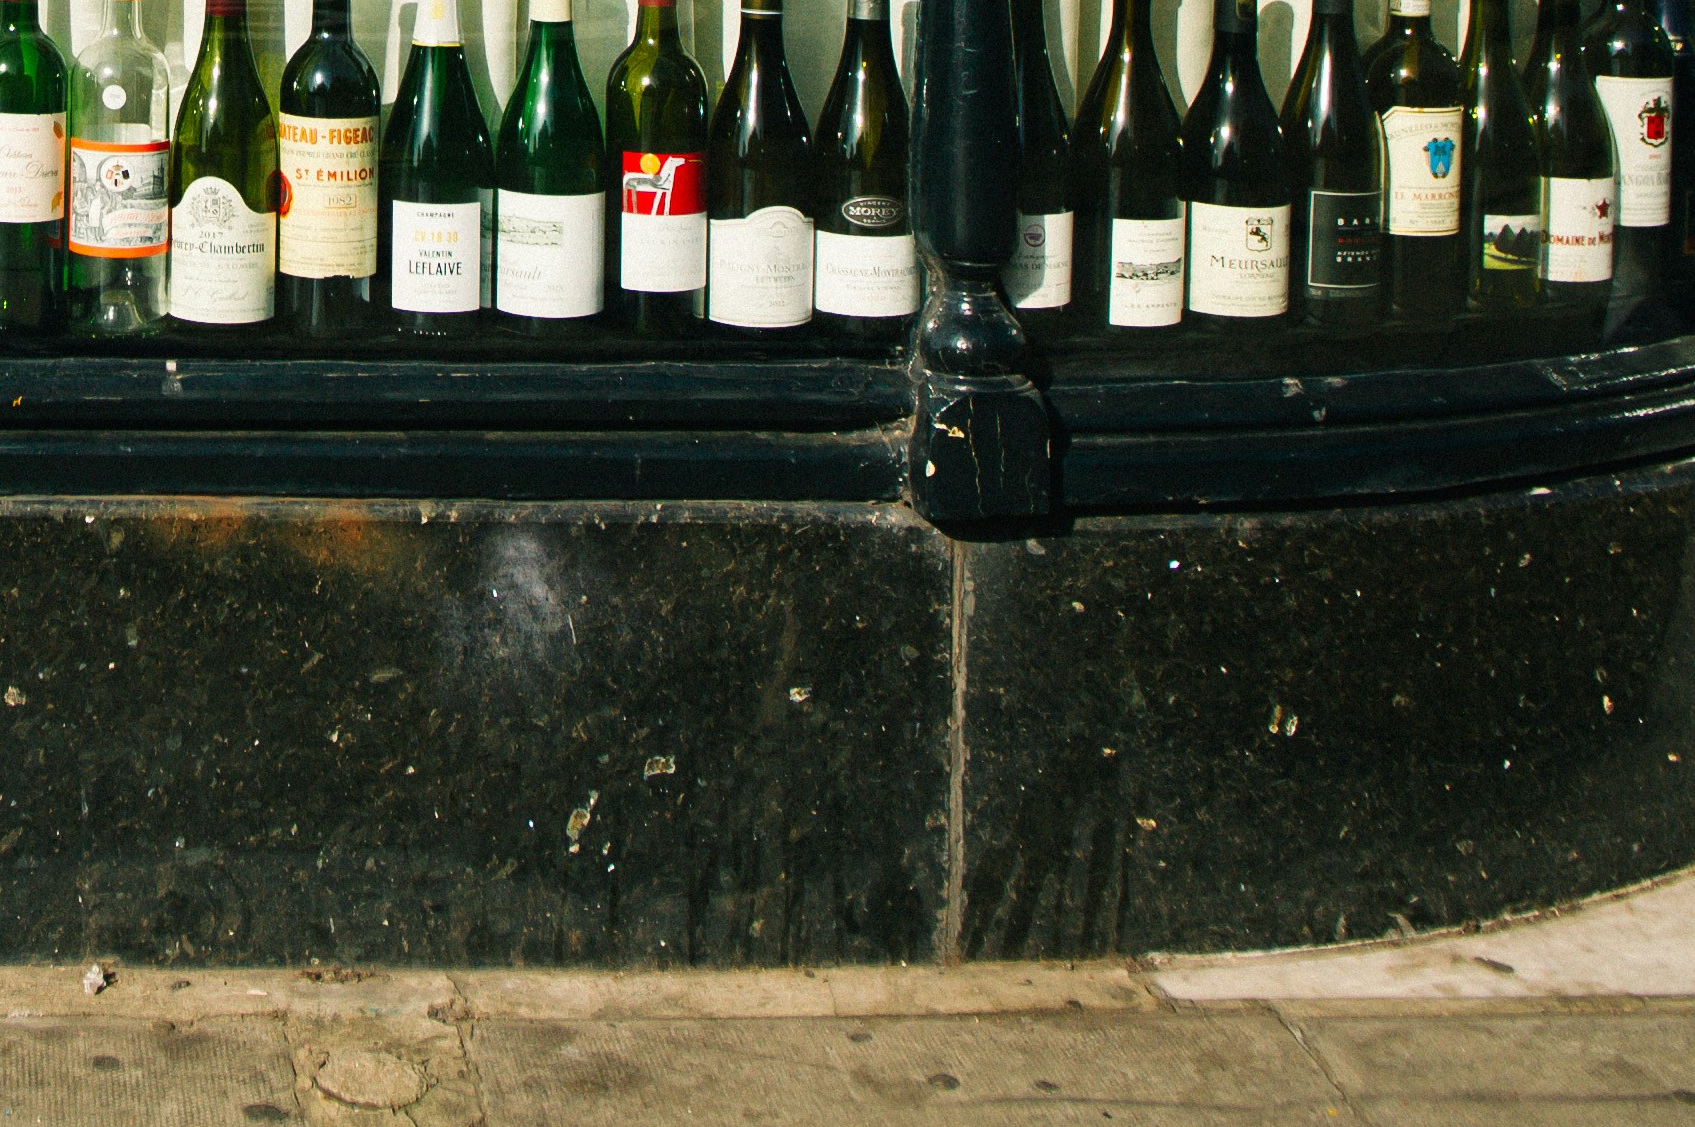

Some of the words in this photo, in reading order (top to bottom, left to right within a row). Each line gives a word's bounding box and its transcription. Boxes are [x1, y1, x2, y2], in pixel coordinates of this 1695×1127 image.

[316, 165, 375, 183] ÉMILION
[327, 192, 353, 207] 1982
[848, 205, 899, 219] MOREY
[198, 230, 224, 239] 2017
[447, 231, 459, 244] 30
[419, 249, 454, 258] VALENTIN
[408, 259, 463, 276] LEFLAIVE
